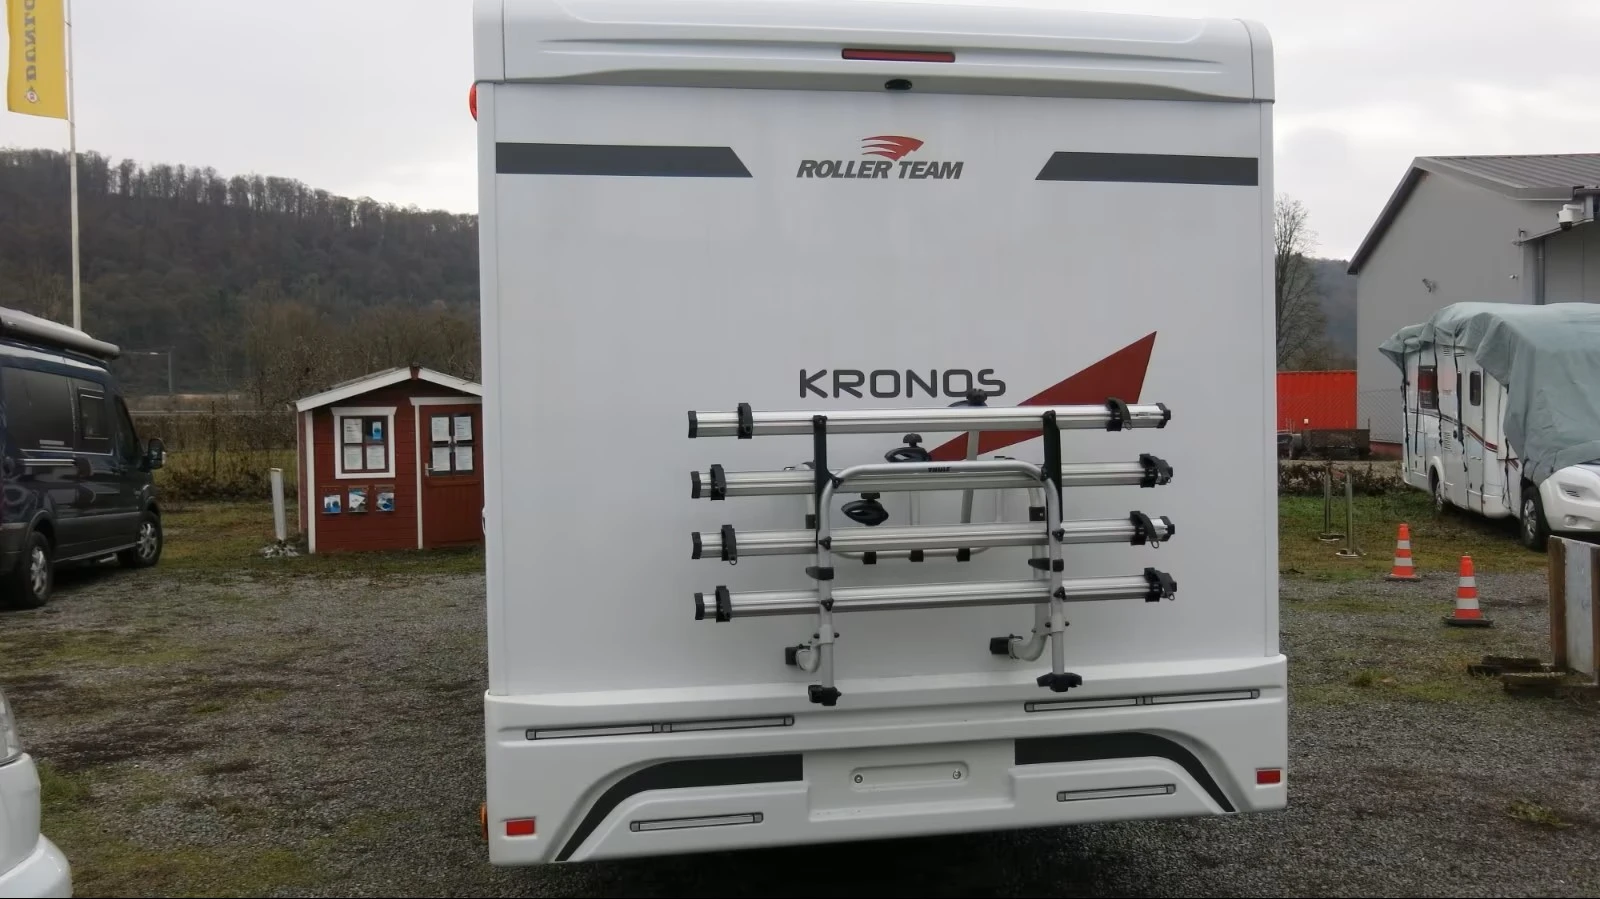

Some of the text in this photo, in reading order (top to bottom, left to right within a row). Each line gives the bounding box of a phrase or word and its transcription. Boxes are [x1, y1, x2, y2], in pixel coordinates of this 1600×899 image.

[796, 159, 964, 180] ROLLER TEAM
[799, 368, 1007, 398] KRONOS
